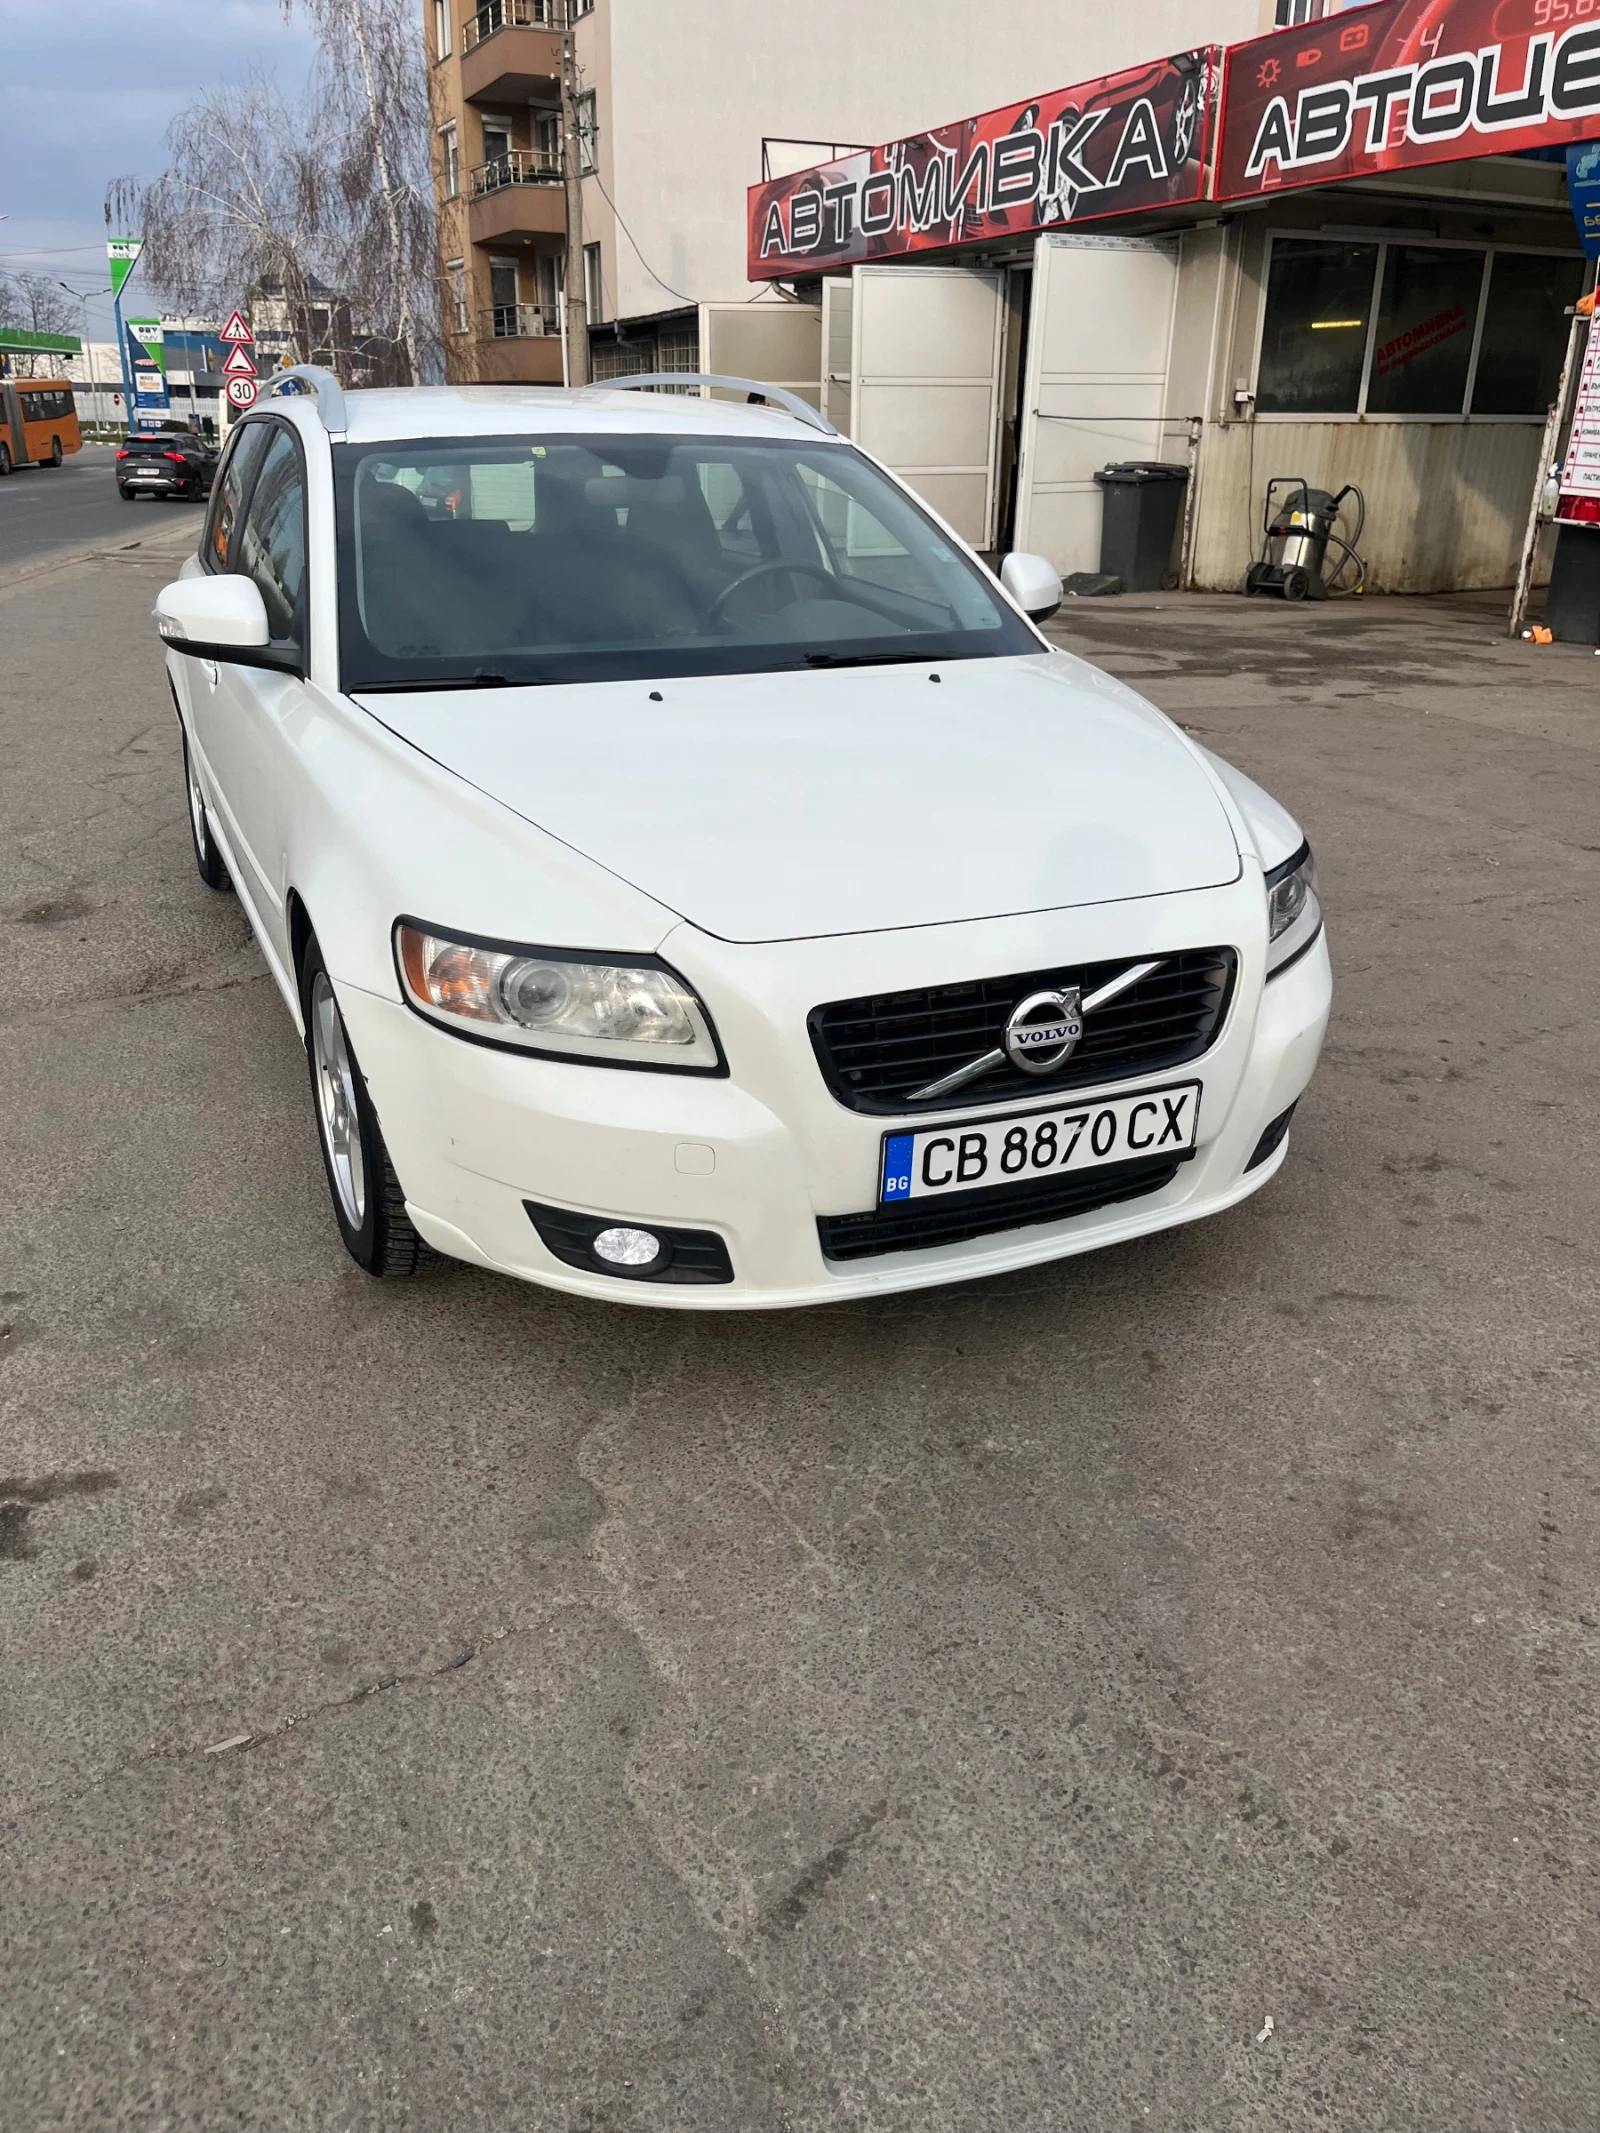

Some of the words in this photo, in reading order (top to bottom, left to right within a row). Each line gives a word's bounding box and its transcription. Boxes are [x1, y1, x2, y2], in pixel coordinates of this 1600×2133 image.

[760, 97, 1169, 258] АВТОМИВКА
[139, 334, 158, 342] OMV
[233, 383, 251, 399] 30
[1014, 1023, 1080, 1045] VOLVO
[921, 1133, 988, 1187] CB
[1000, 1109, 1118, 1175] 8870
[1126, 1095, 1188, 1150] CX
[886, 1177, 908, 1192] BG
